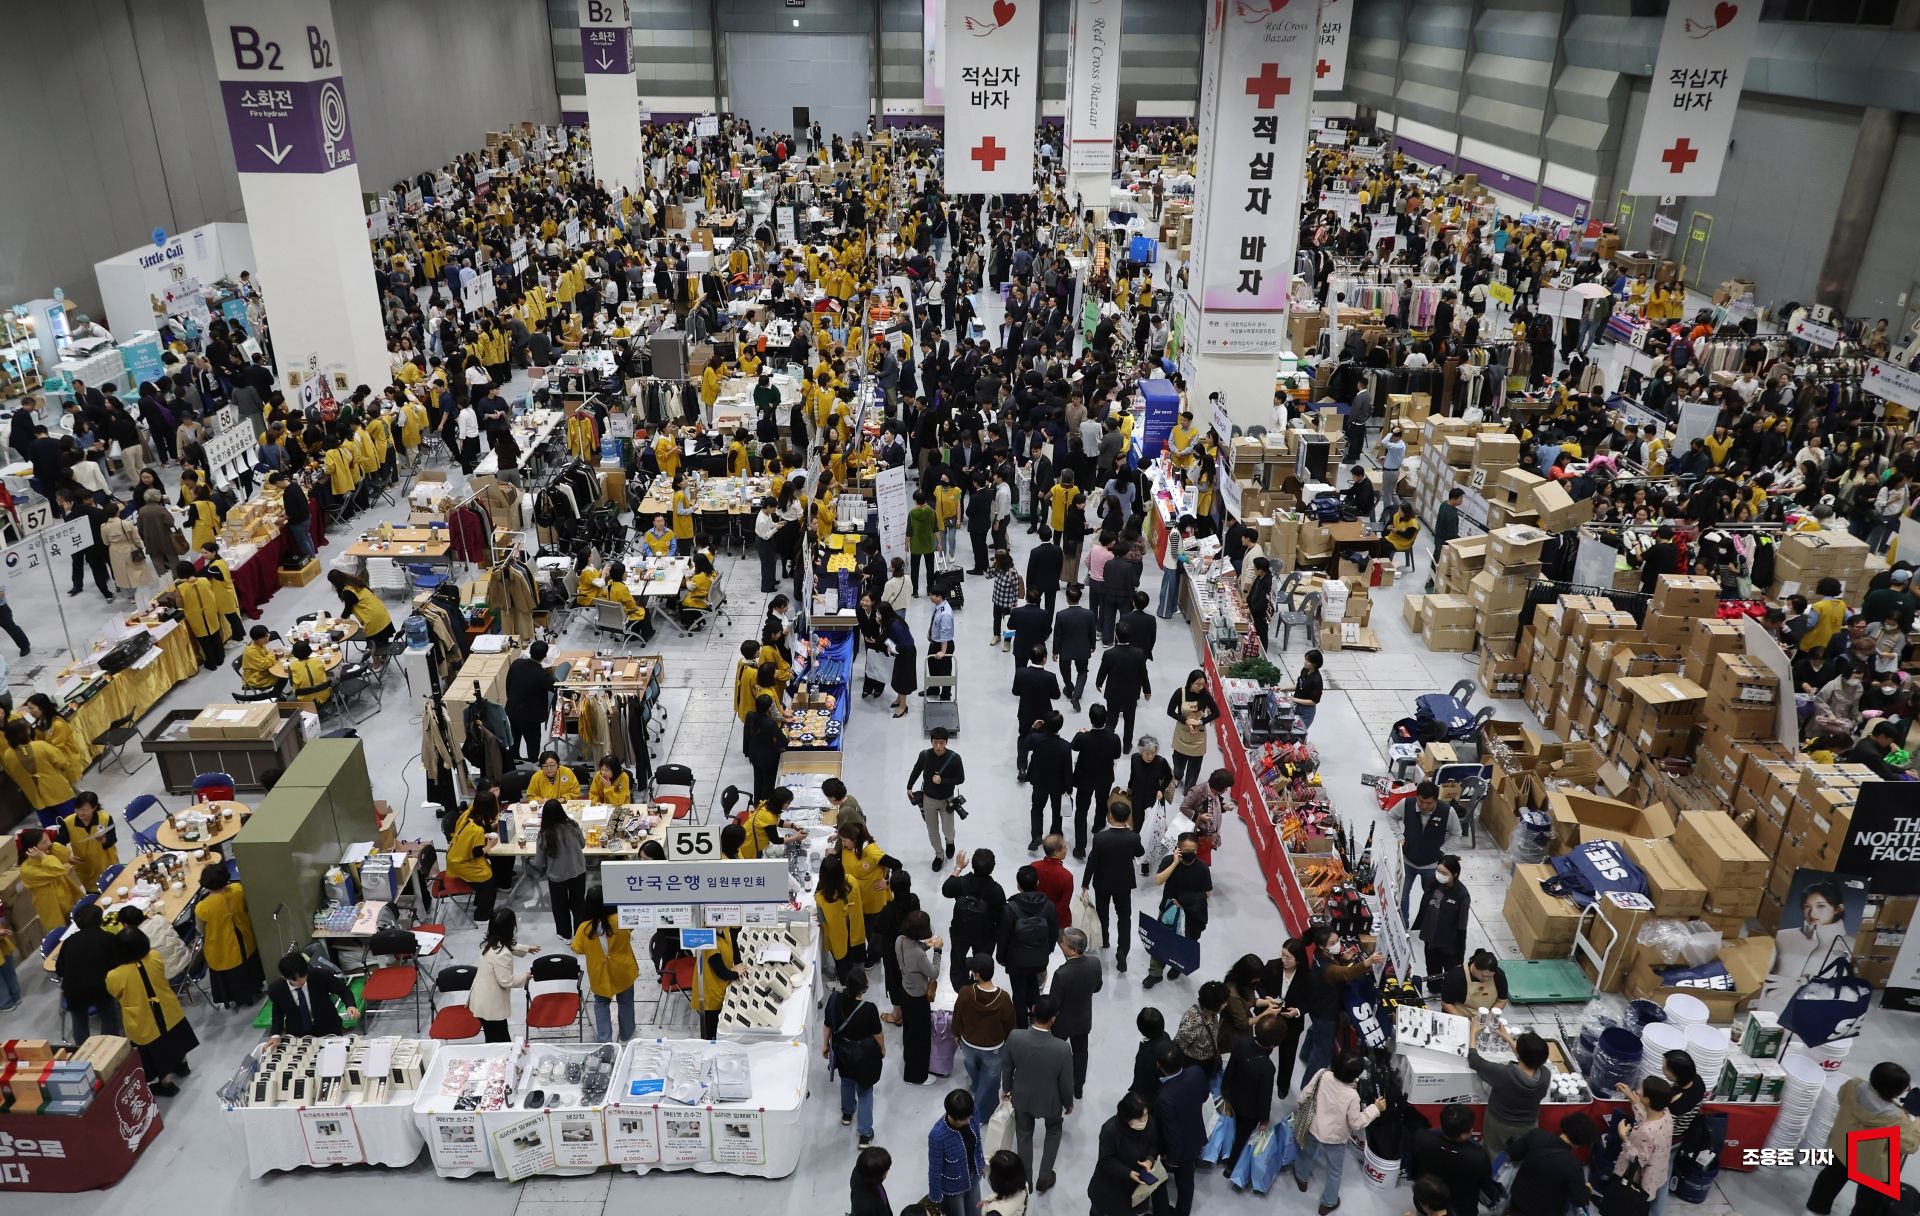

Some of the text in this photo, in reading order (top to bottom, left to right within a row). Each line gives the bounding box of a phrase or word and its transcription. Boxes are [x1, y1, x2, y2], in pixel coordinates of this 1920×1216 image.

[588, 0, 613, 23] B2
[1264, 21, 1308, 31] Red Cross
[1321, 22, 1343, 34] 십자
[590, 31, 616, 42] 소화전
[1264, 34, 1297, 43] Bazaar
[230, 26, 284, 70] B2
[307, 26, 333, 69] B2
[961, 66, 1021, 87] 적십자
[1088, 18, 1106, 129] Red Cross Bazaar
[1669, 68, 1728, 89] 적십자
[241, 89, 293, 109] 소화전
[971, 90, 1009, 110] 바자
[1673, 92, 1712, 111] 바자
[1237, 116, 1279, 295] 적십자 바자
[166, 244, 184, 259] Cali
[172, 267, 184, 279] 79
[1561, 274, 1571, 286] 20
[1817, 308, 1824, 319] 5
[1632, 333, 1643, 345] 21
[309, 355, 317, 370] 59
[1895, 352, 1903, 361] 4
[220, 411, 231, 427] 58
[1473, 471, 1484, 486] 22
[28, 508, 46, 529] 57
[1893, 817, 1920, 832] TH
[676, 832, 713, 855] 55
[1585, 848, 1628, 881] SEE
[626, 875, 766, 891] 한국은행 임원부인회
[1352, 1002, 1385, 1048] SEE
[0, 1163, 30, 1183] 다
